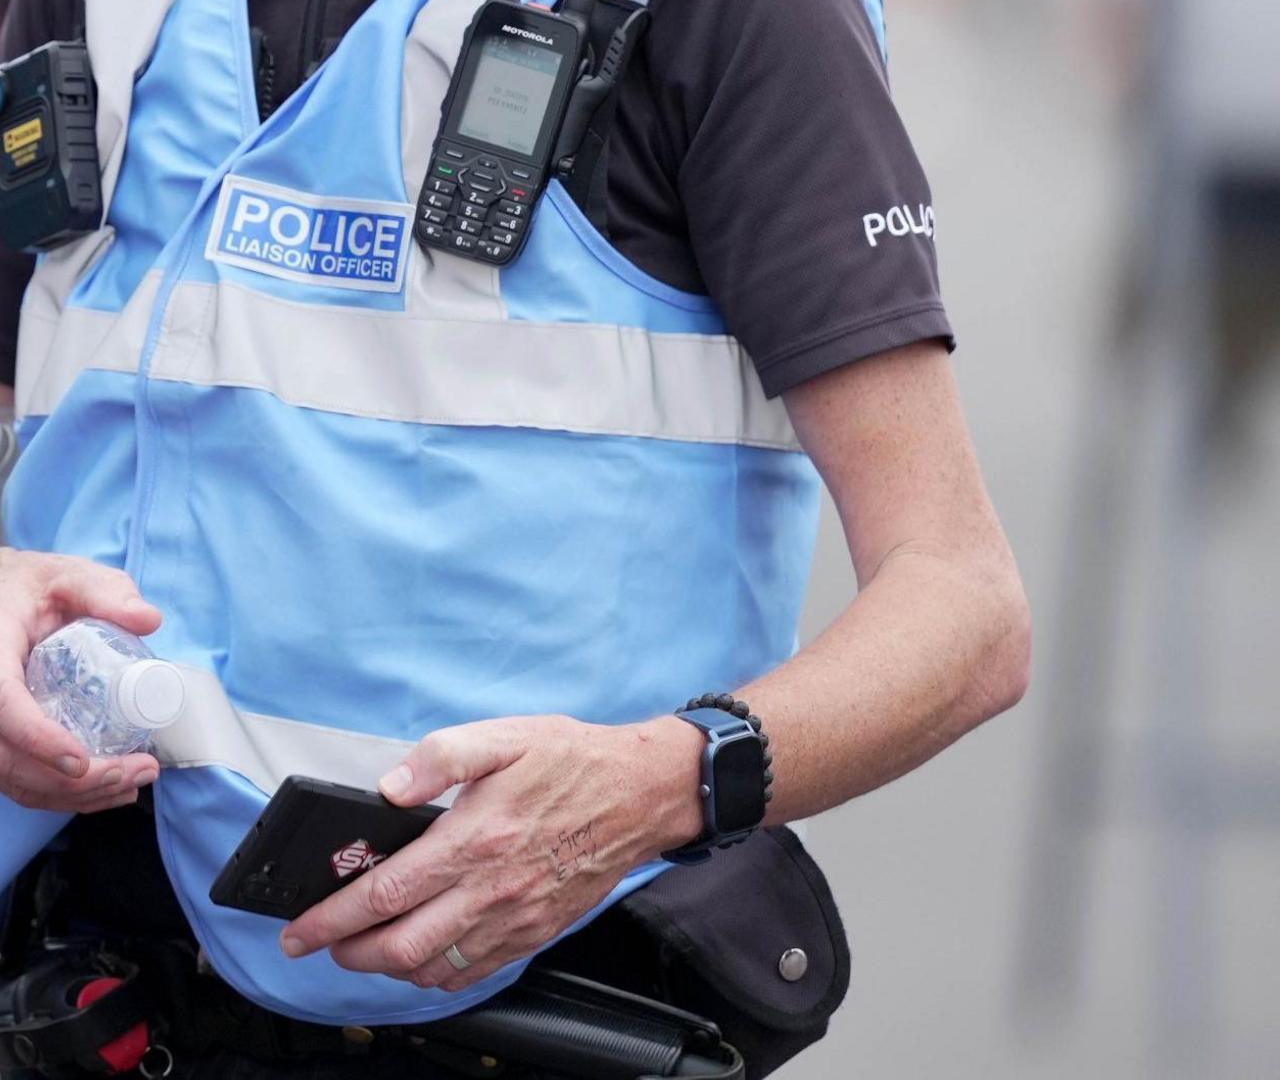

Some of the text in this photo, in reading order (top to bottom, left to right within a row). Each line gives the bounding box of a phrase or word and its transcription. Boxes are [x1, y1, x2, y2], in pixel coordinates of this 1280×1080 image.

[501, 24, 555, 46] MOTOROLA
[435, 181, 441, 190] 1
[428, 195, 436, 205] 4
[469, 192, 477, 201] 2
[424, 209, 431, 219] 7
[465, 206, 472, 216] 5
[515, 205, 522, 215] 3
[232, 195, 401, 258] POLICE
[460, 221, 468, 230] 8
[509, 220, 517, 229] 6
[863, 203, 937, 247] POLIC
[455, 236, 463, 246] 0
[504, 234, 512, 244] 9
[225, 233, 393, 279] LIAISON OFFICER
